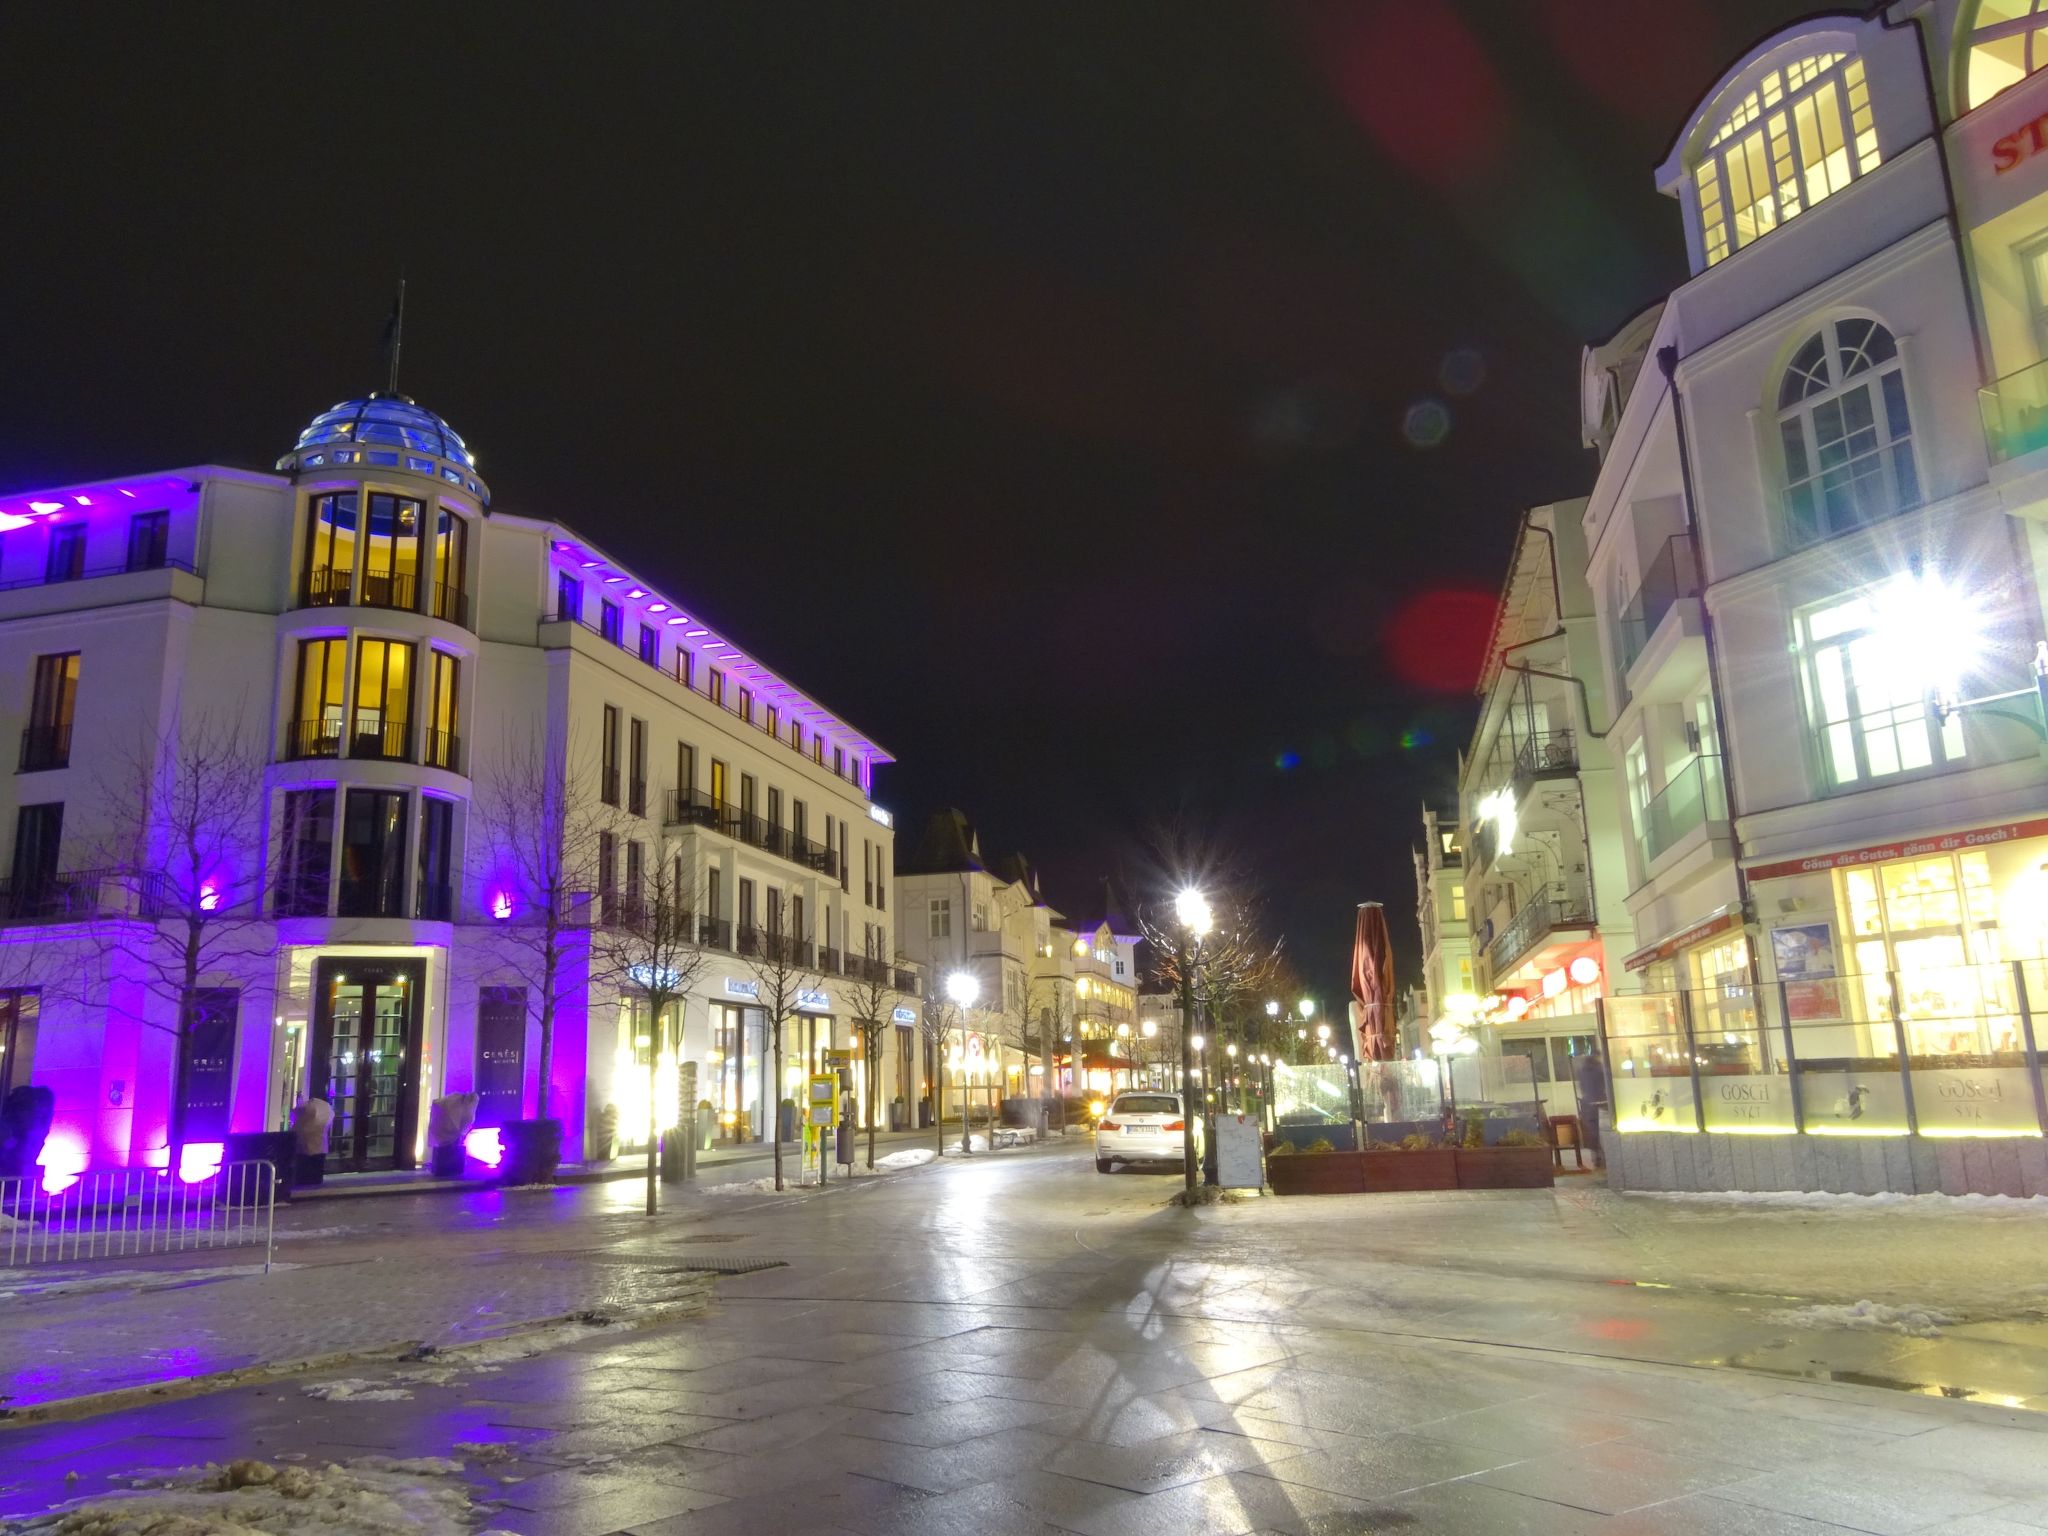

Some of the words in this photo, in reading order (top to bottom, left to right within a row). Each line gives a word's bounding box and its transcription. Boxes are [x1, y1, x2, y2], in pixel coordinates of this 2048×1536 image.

[1802, 858, 1833, 871] Gönn
[1837, 854, 1856, 865] dir
[1903, 842, 1936, 856] gönn
[1940, 837, 1960, 849] dir
[1965, 829, 2007, 844] Gosch
[1721, 1083, 1769, 1101] GOSCH
